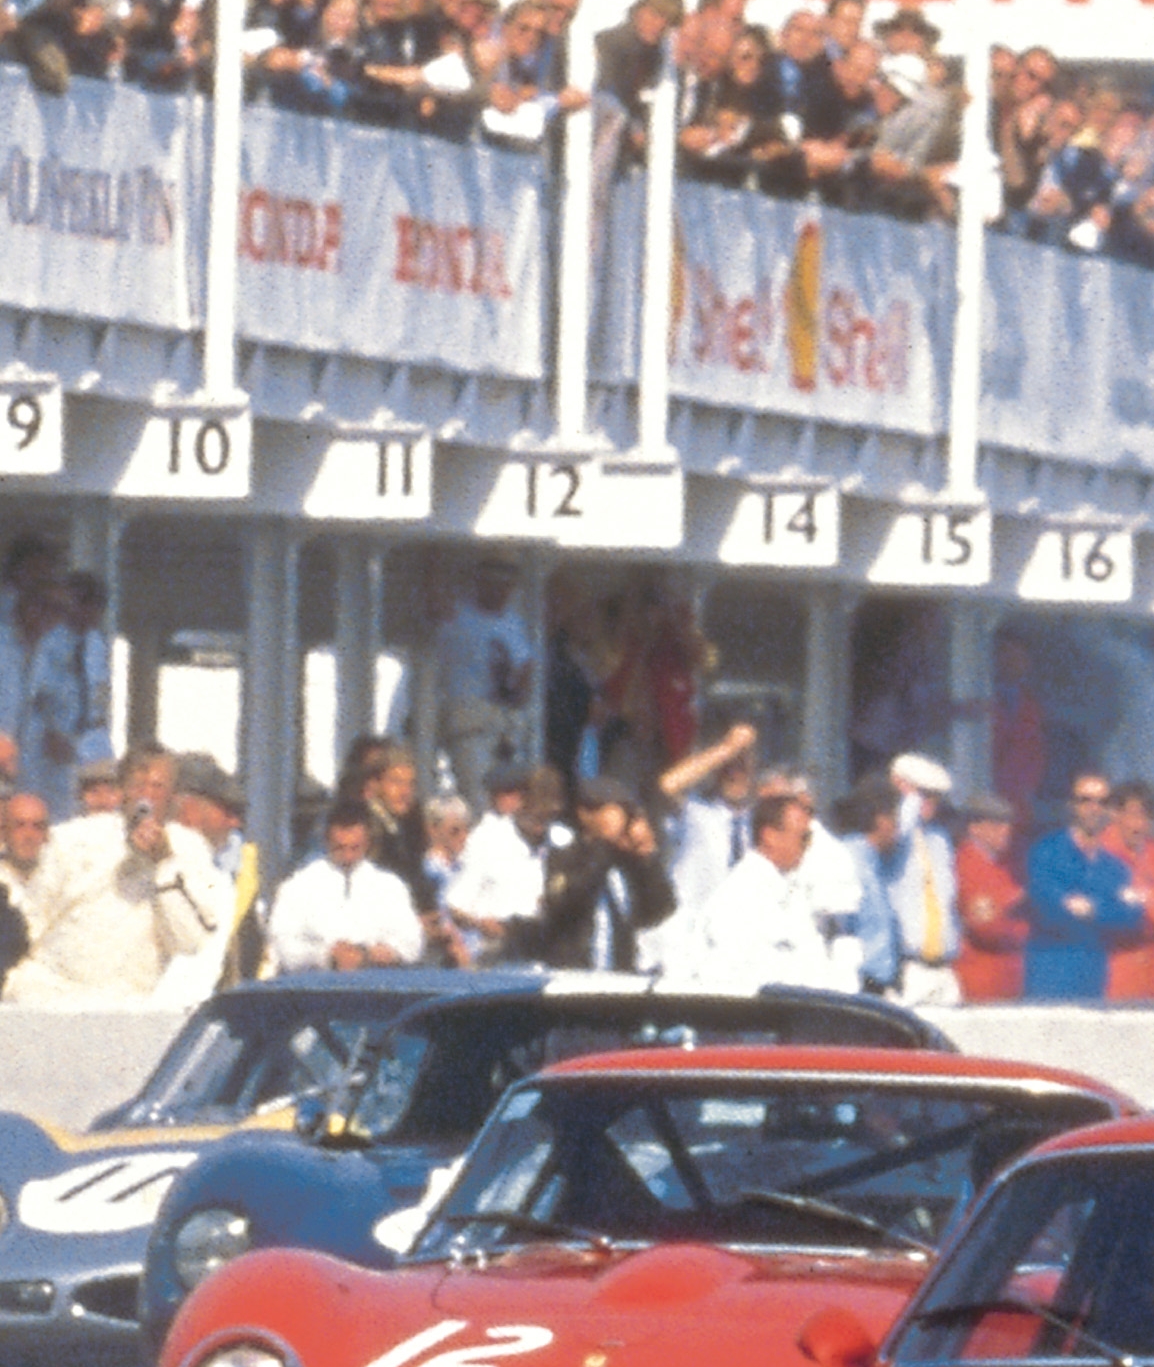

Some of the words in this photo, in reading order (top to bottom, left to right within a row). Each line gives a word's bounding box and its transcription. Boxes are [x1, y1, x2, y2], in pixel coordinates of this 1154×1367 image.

[168, 416, 230, 475] 10
[377, 437, 411, 497] 11
[526, 463, 583, 518] 12
[764, 492, 816, 544] 14
[921, 511, 972, 565] 15
[1061, 531, 1114, 583] 16
[58, 1161, 178, 1203] 11
